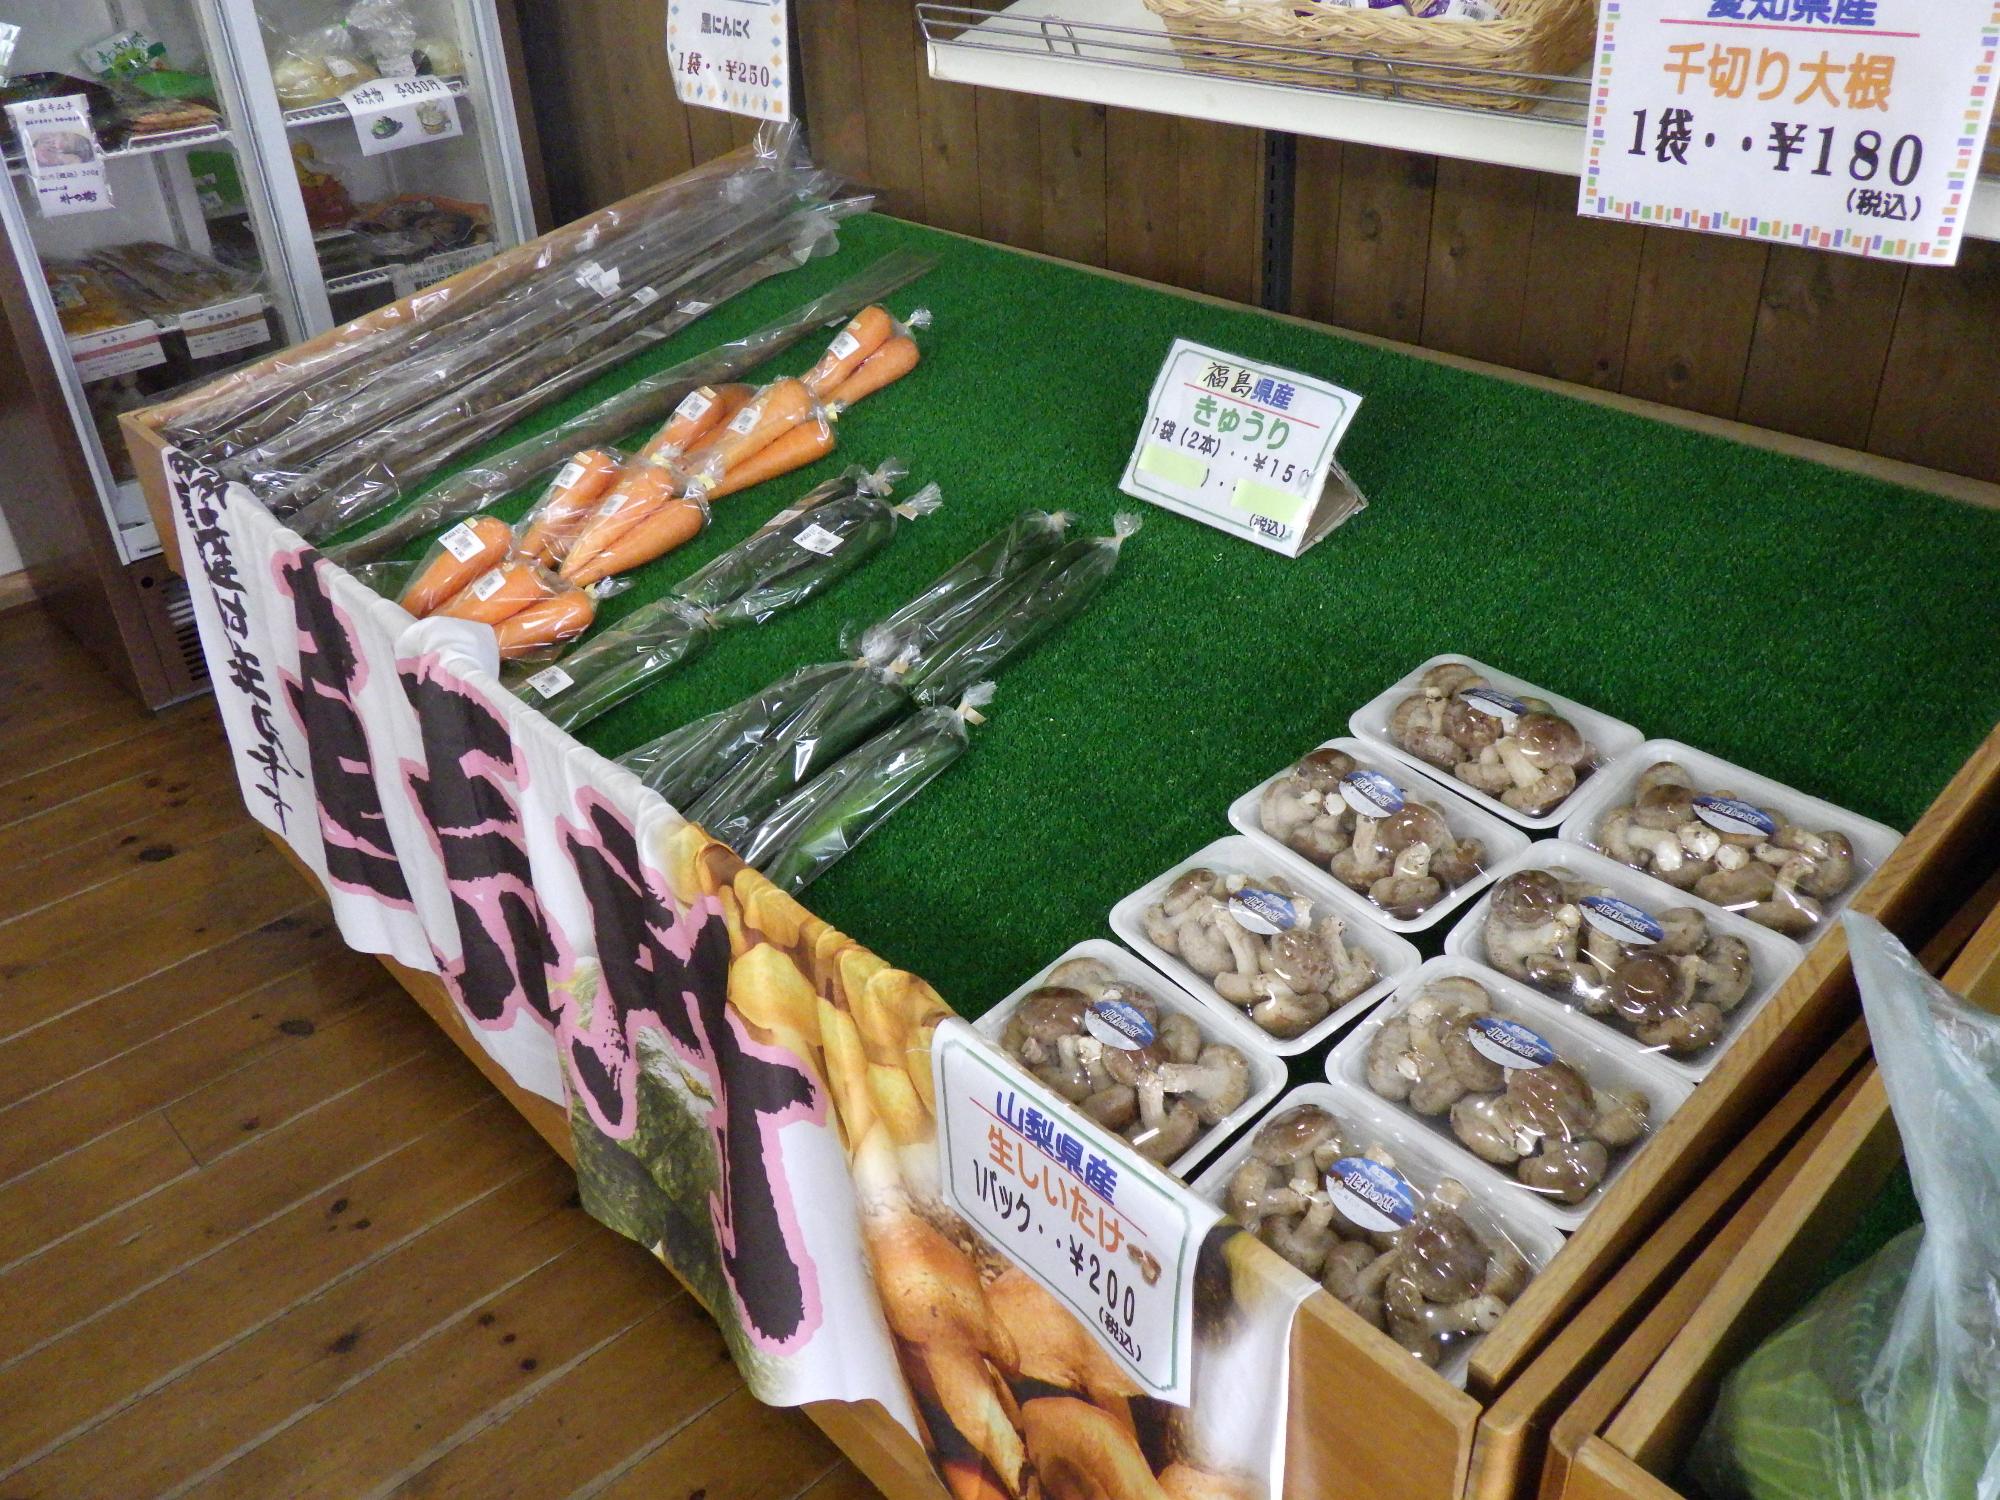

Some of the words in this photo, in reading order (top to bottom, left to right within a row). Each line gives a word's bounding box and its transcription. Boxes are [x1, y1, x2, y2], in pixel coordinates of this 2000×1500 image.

[700, 12, 751, 39] 黒にんにく
[1663, 42, 1897, 112] 千切り大根
[1846, 187, 1922, 222] (税込)
[1202, 361, 1296, 411] 福島県産
[1192, 394, 1291, 450] きゅうり
[996, 1090, 1118, 1206] 山梨県産
[986, 1125, 1125, 1254] 生しいたけ
[1097, 1305, 1143, 1363] (税込)
